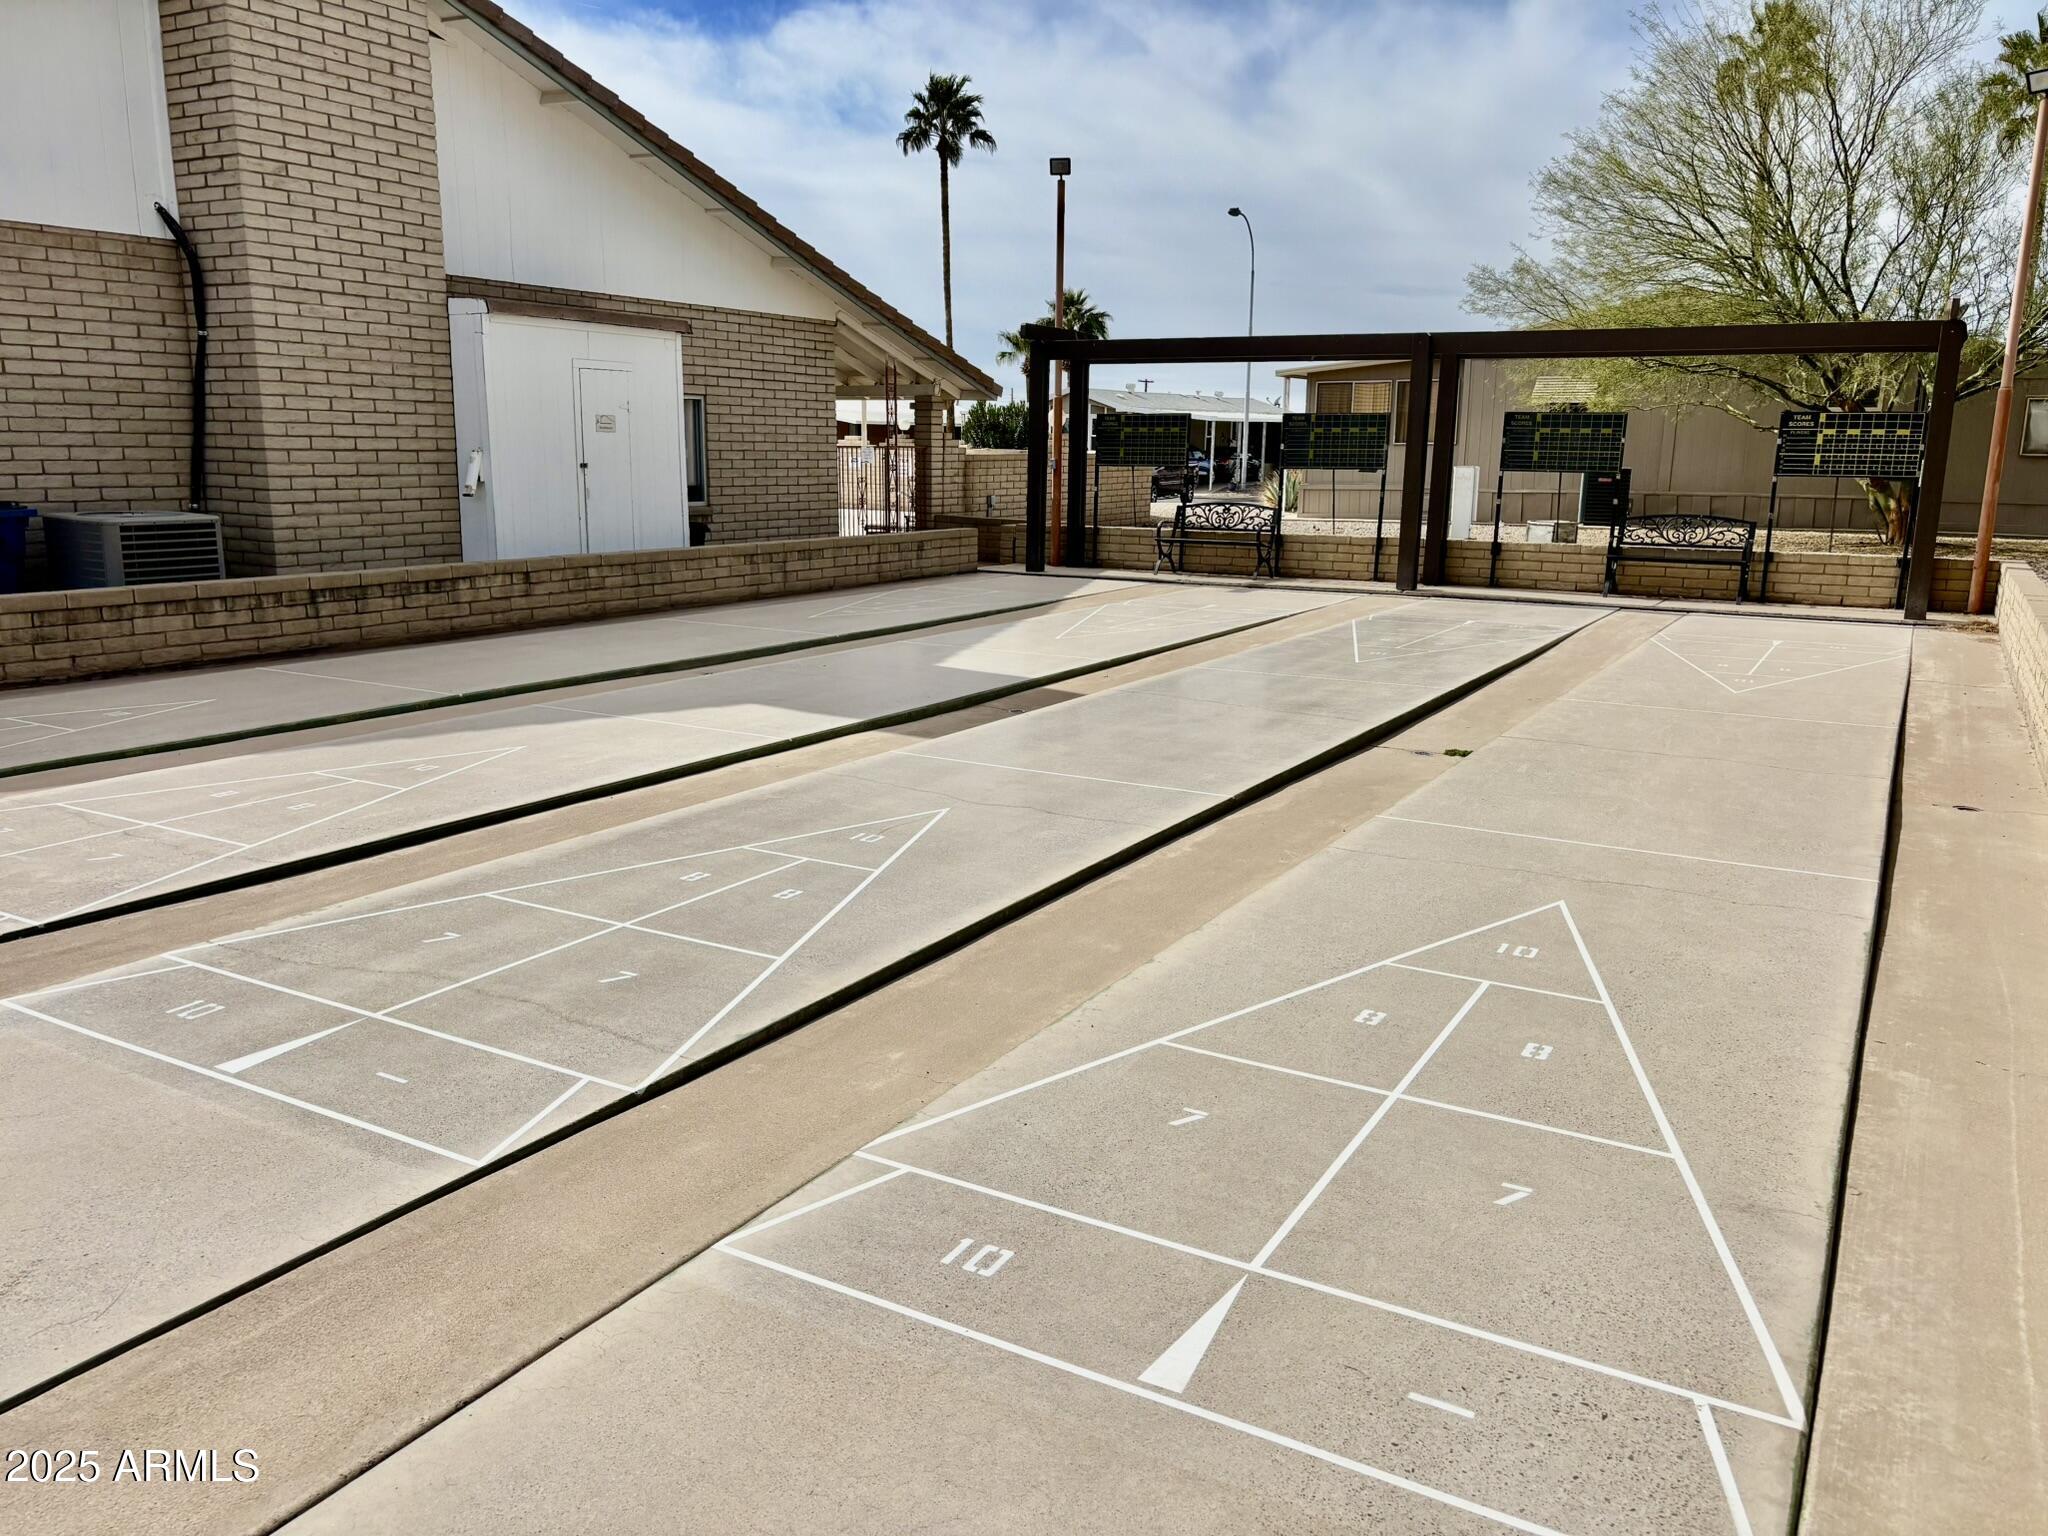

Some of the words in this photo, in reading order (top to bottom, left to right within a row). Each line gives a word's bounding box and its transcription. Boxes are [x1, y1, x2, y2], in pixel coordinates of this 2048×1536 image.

[849, 832, 885, 843] 10
[679, 871, 711, 882] 8
[772, 888, 804, 900] 8
[423, 932, 462, 943] 7
[1494, 941, 1540, 959] 10
[598, 970, 638, 983] 7
[165, 999, 226, 1020] 10
[1353, 1009, 1387, 1026] 8
[1520, 1042, 1554, 1060] 8
[1168, 1107, 1209, 1126] 7
[1492, 1182, 1533, 1206] 7
[940, 1237, 1015, 1277] 10
